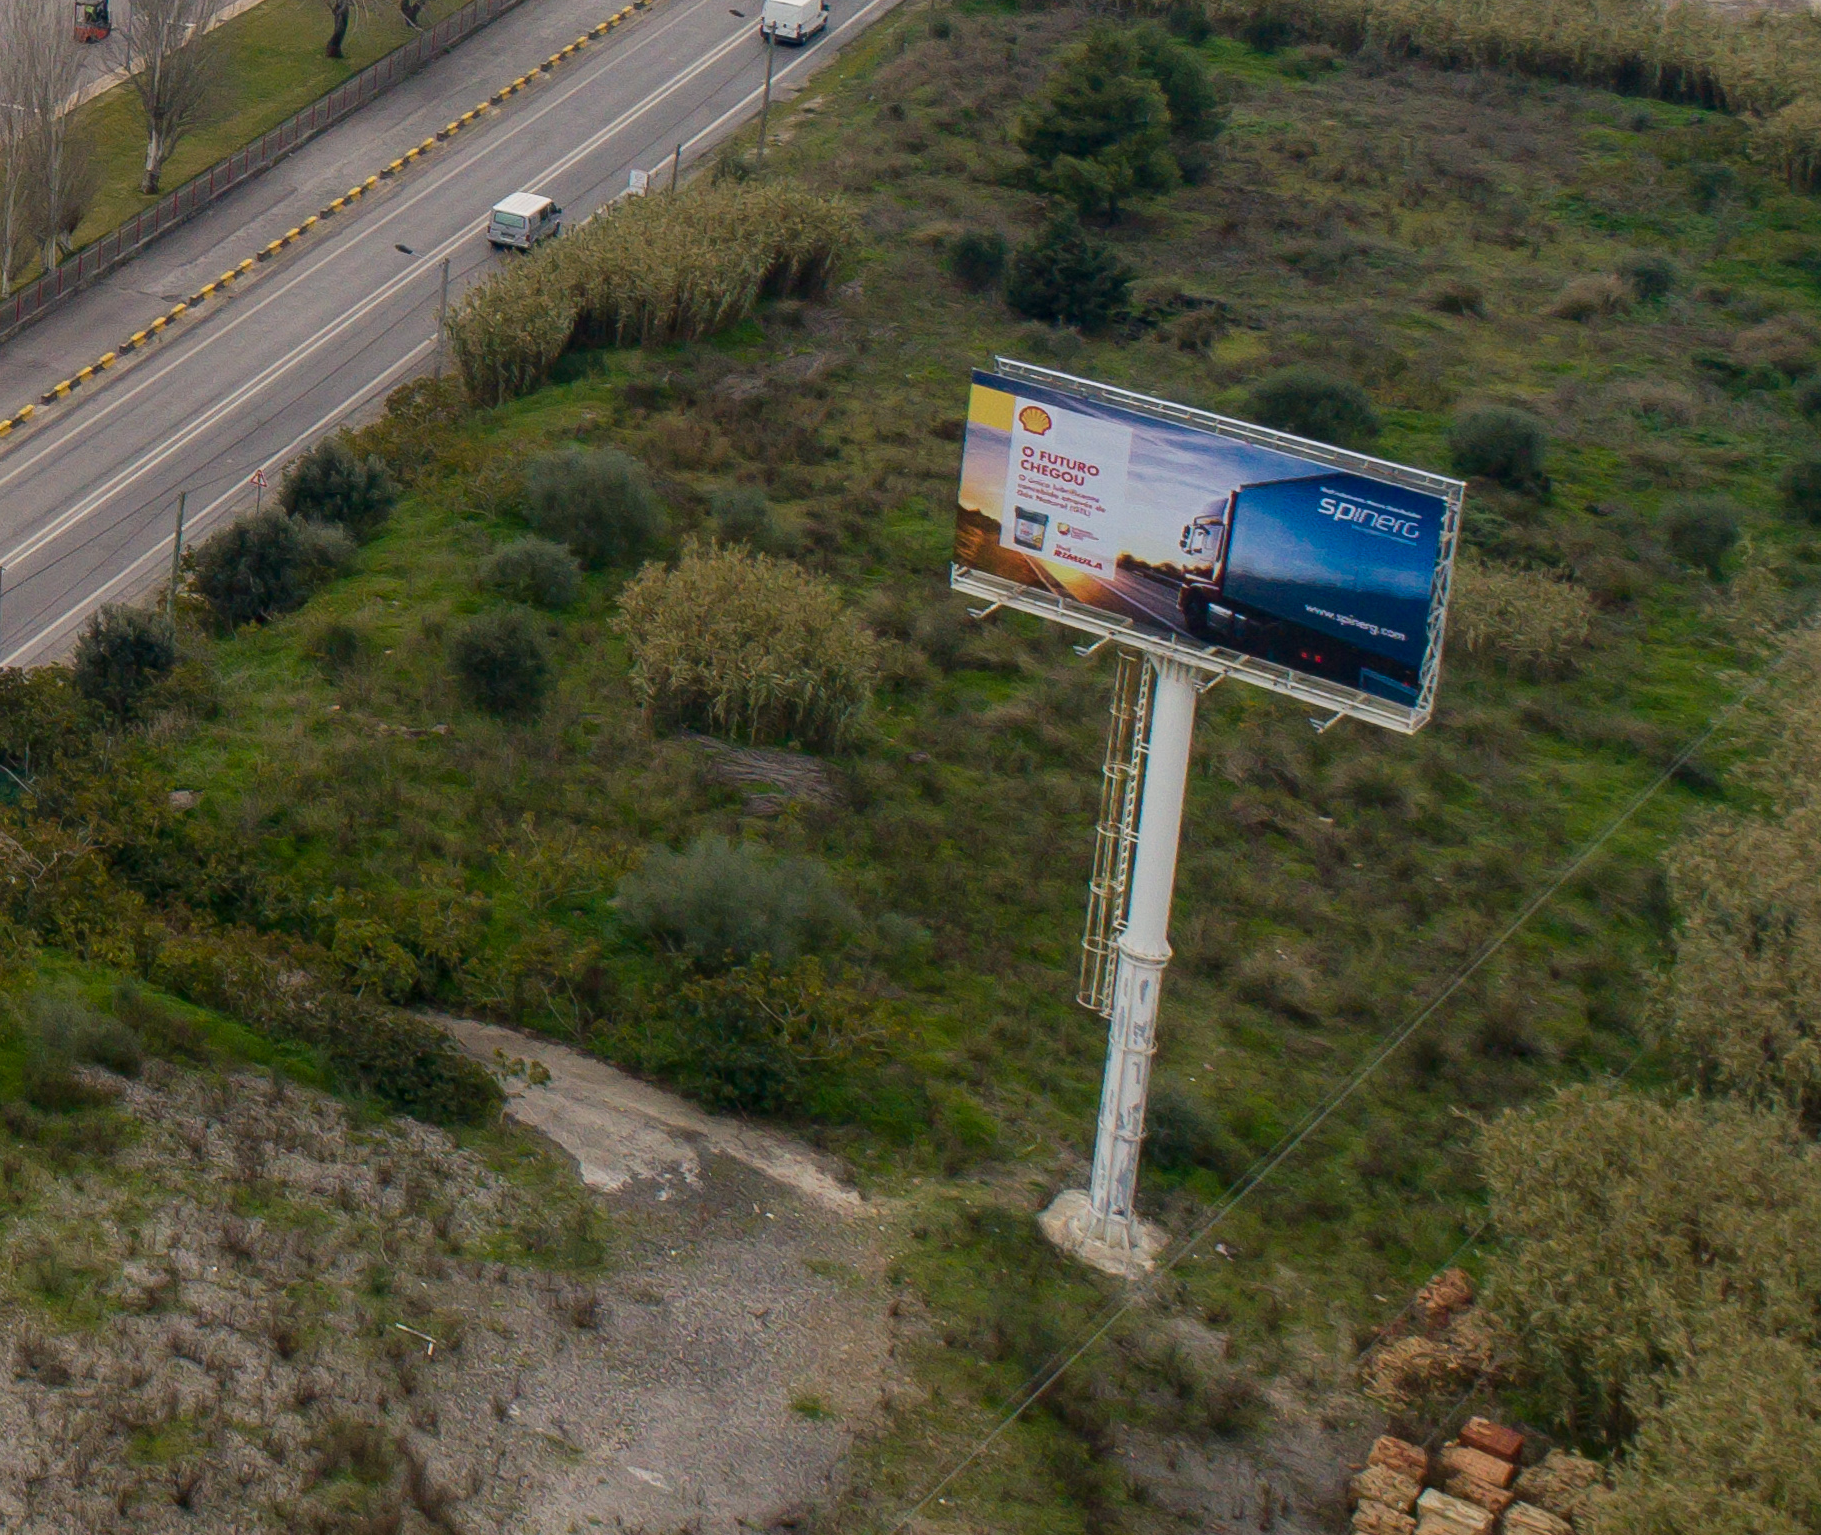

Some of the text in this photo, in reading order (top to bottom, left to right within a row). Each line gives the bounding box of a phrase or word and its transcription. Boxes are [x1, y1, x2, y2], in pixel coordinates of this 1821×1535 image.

[1020, 459, 1085, 486] CHEGOU
[1021, 445, 1100, 477] O FUTURO
